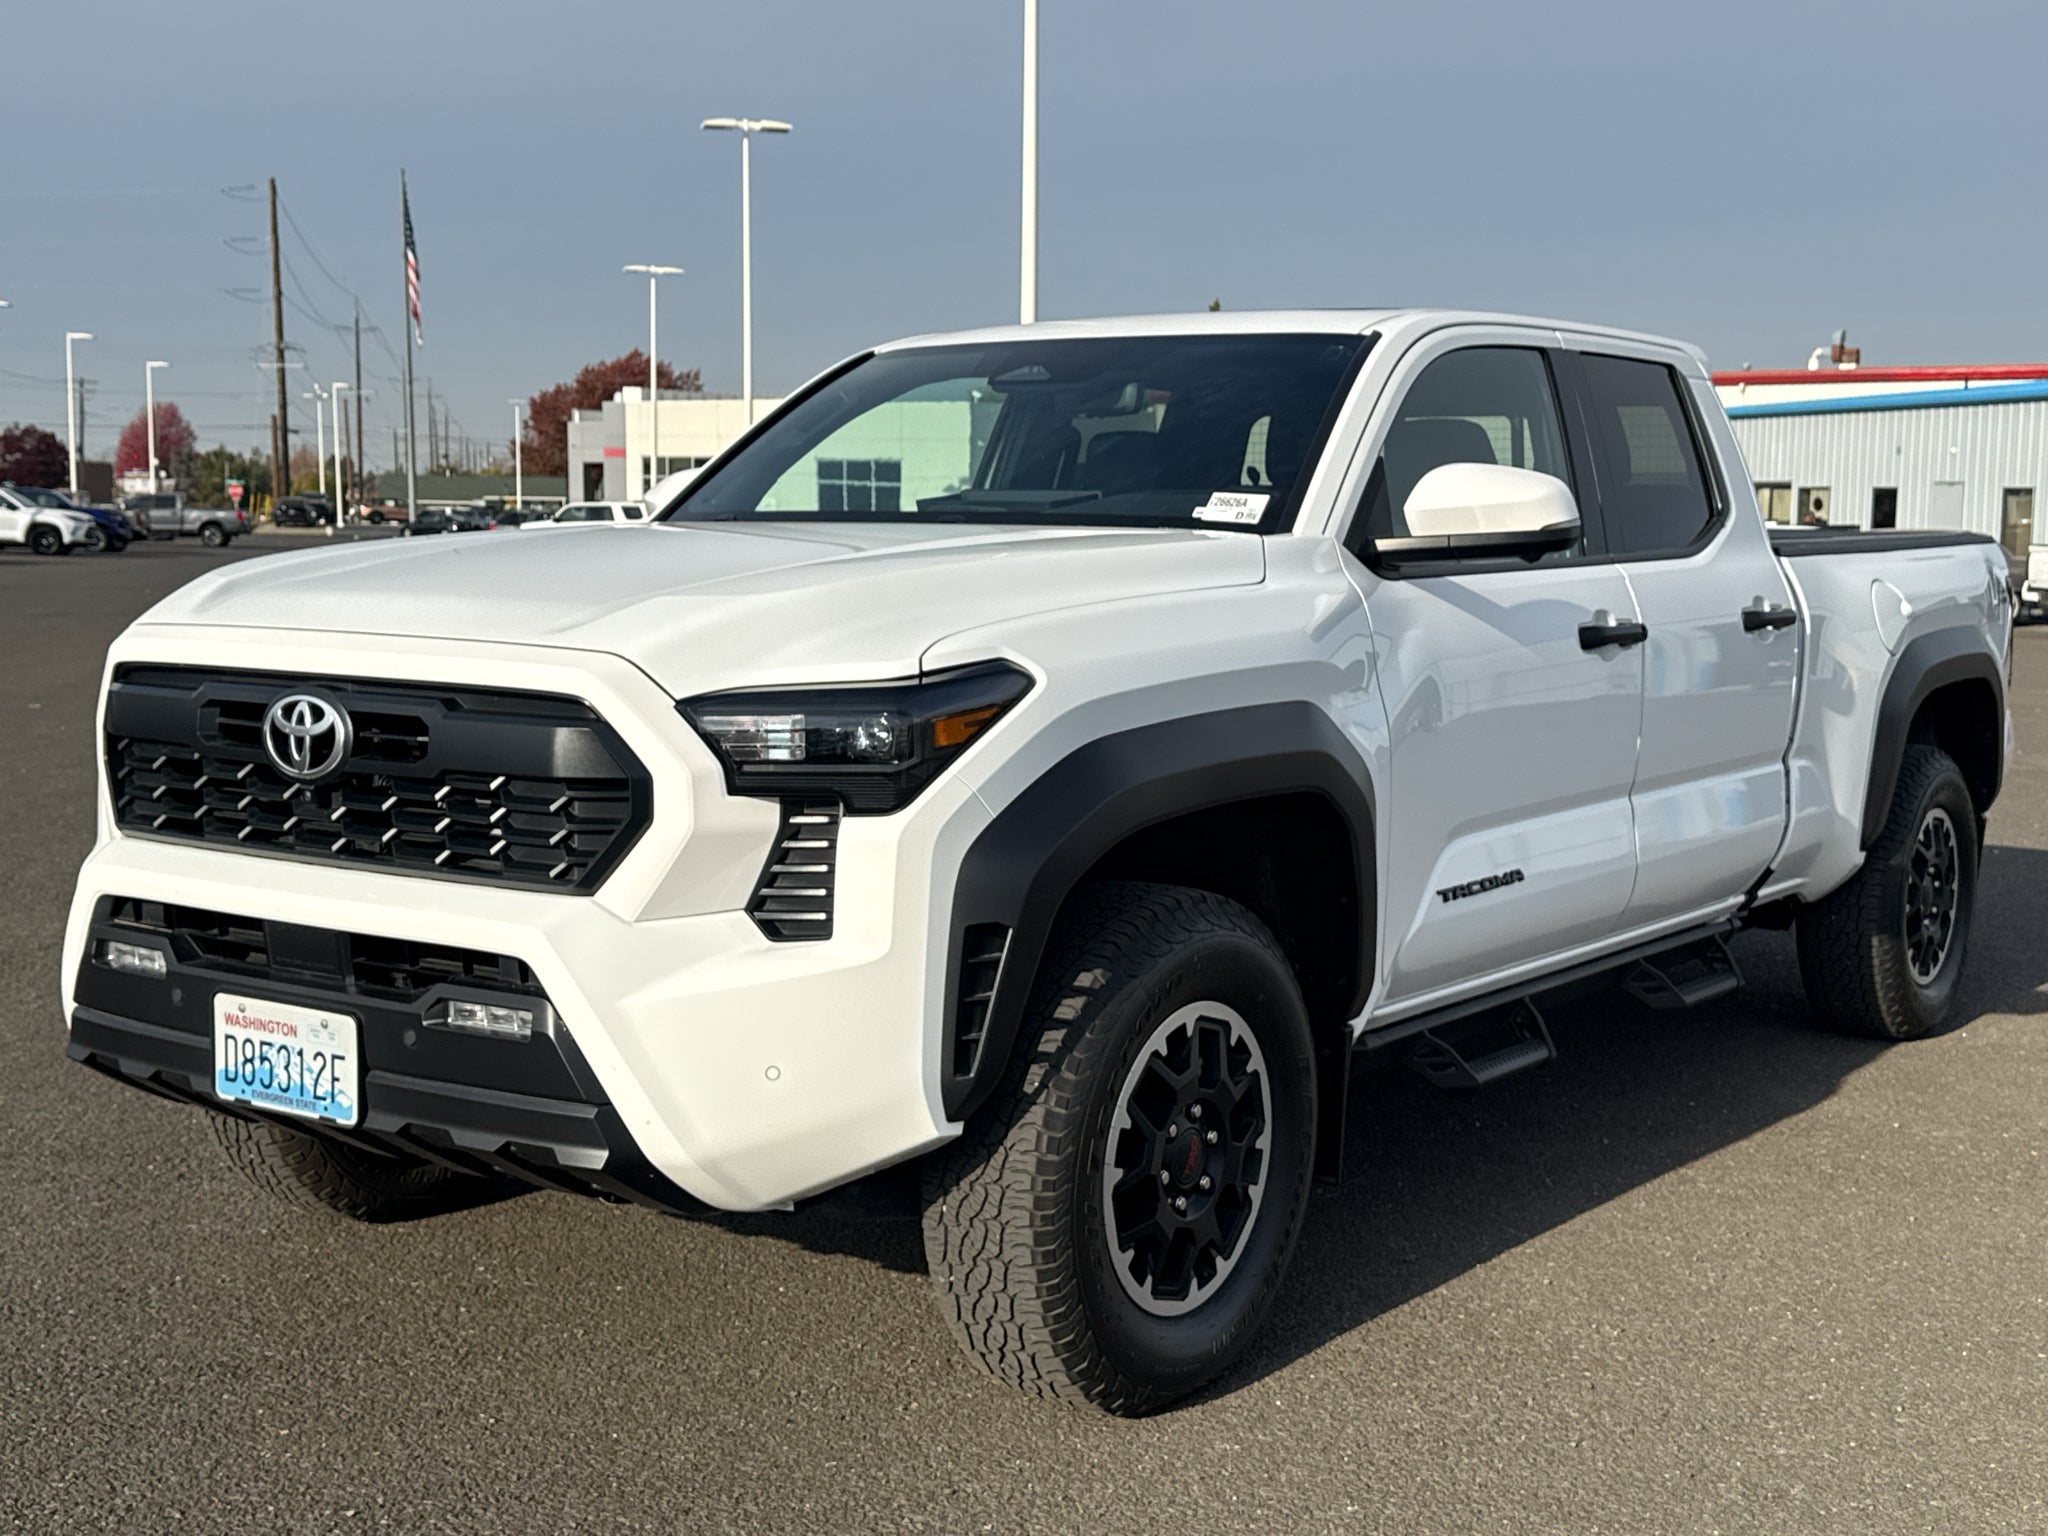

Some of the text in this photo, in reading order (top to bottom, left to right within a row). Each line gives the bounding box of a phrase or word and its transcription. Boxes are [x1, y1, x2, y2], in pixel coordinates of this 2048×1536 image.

[1436, 868, 1525, 903] TACOMA
[224, 1012, 298, 1037] WASHINGTON
[224, 1034, 345, 1104] D85312F
[251, 1090, 317, 1111] EVERGREEN STATE
